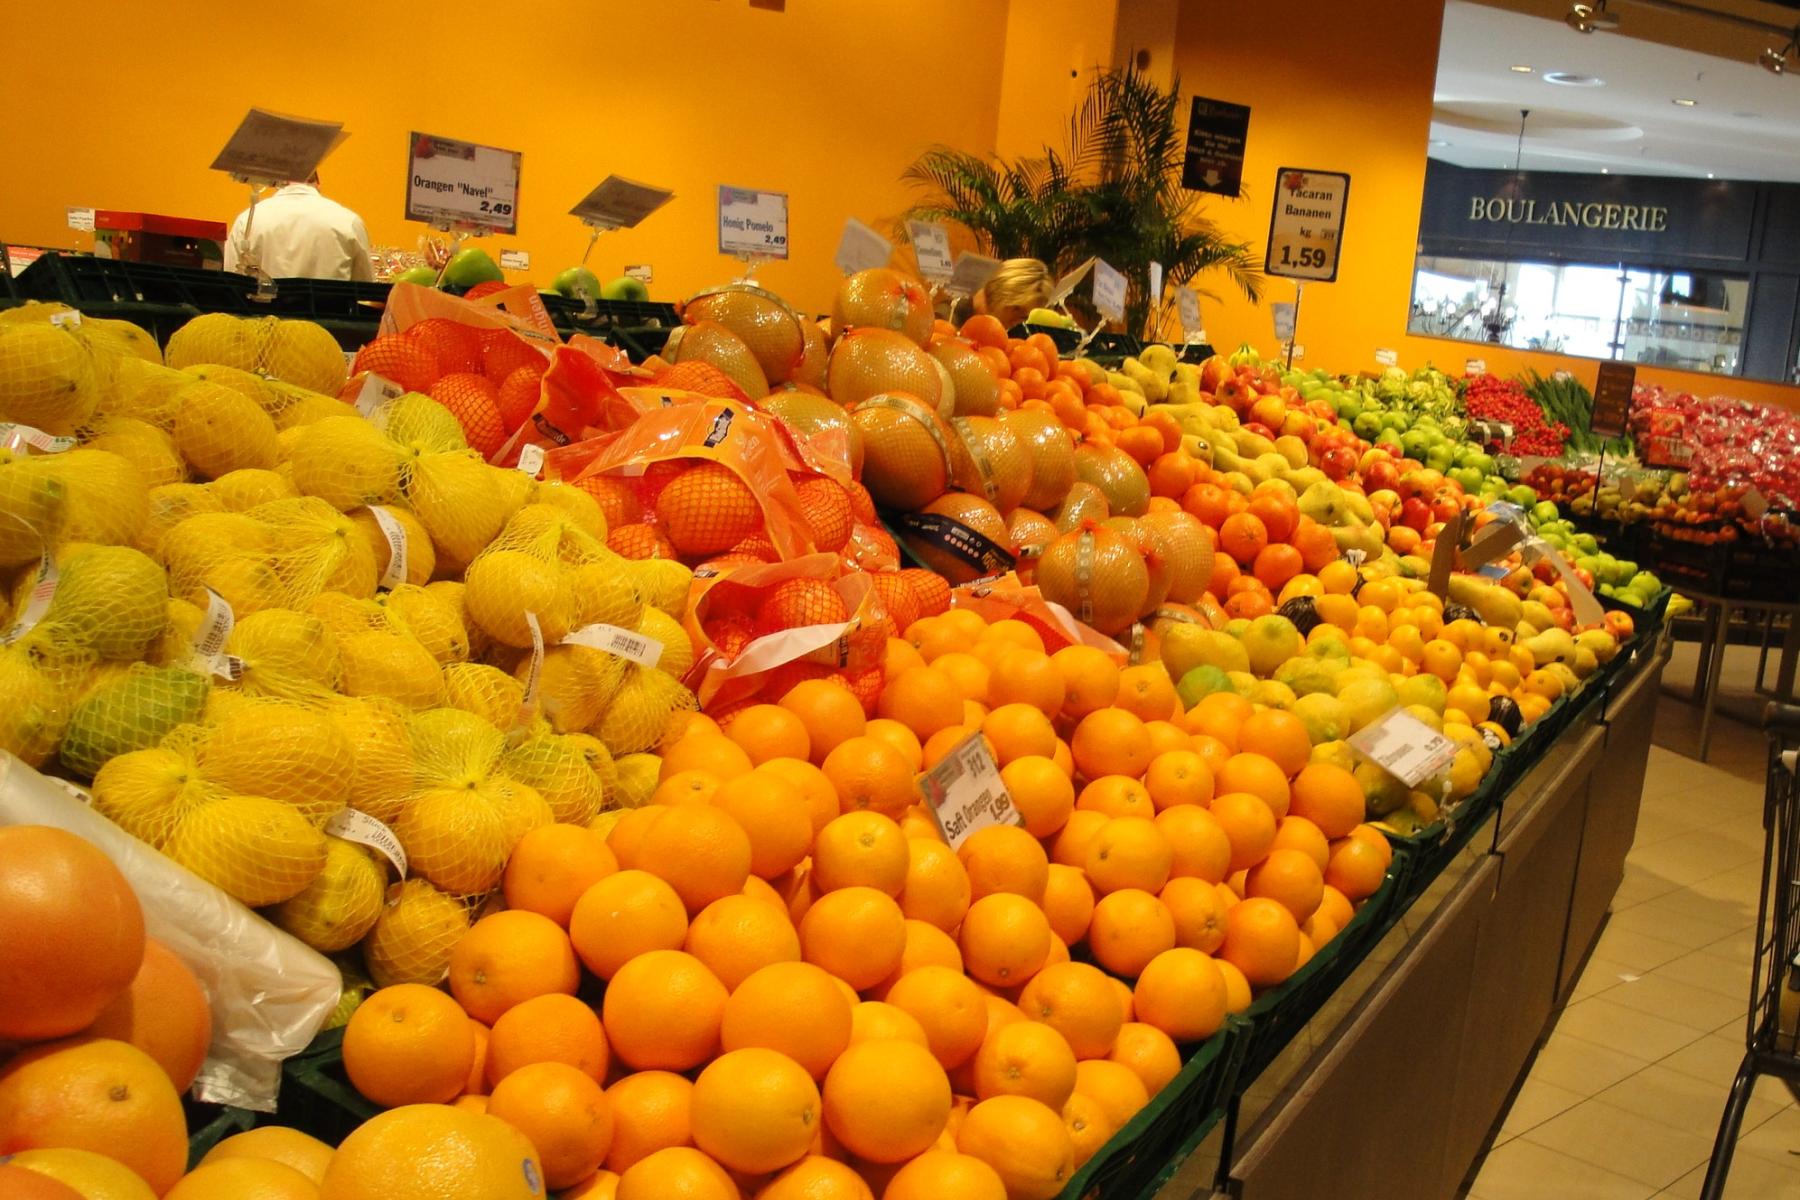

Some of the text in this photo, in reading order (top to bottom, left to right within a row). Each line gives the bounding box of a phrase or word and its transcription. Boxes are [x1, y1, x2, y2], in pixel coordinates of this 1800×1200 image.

[414, 175, 493, 198] Orangen "Navel"
[480, 201, 512, 215] 2,49
[1285, 204, 1332, 220] Bananen
[1470, 197, 1668, 232] BOULANGERIE
[723, 216, 774, 233] Honig Pomelo
[1300, 226, 1312, 239] kg
[765, 234, 786, 245] 2,49
[1280, 245, 1327, 269] 1,59
[945, 788, 993, 840] Saft Orangen
[989, 792, 1011, 821] 1,99
